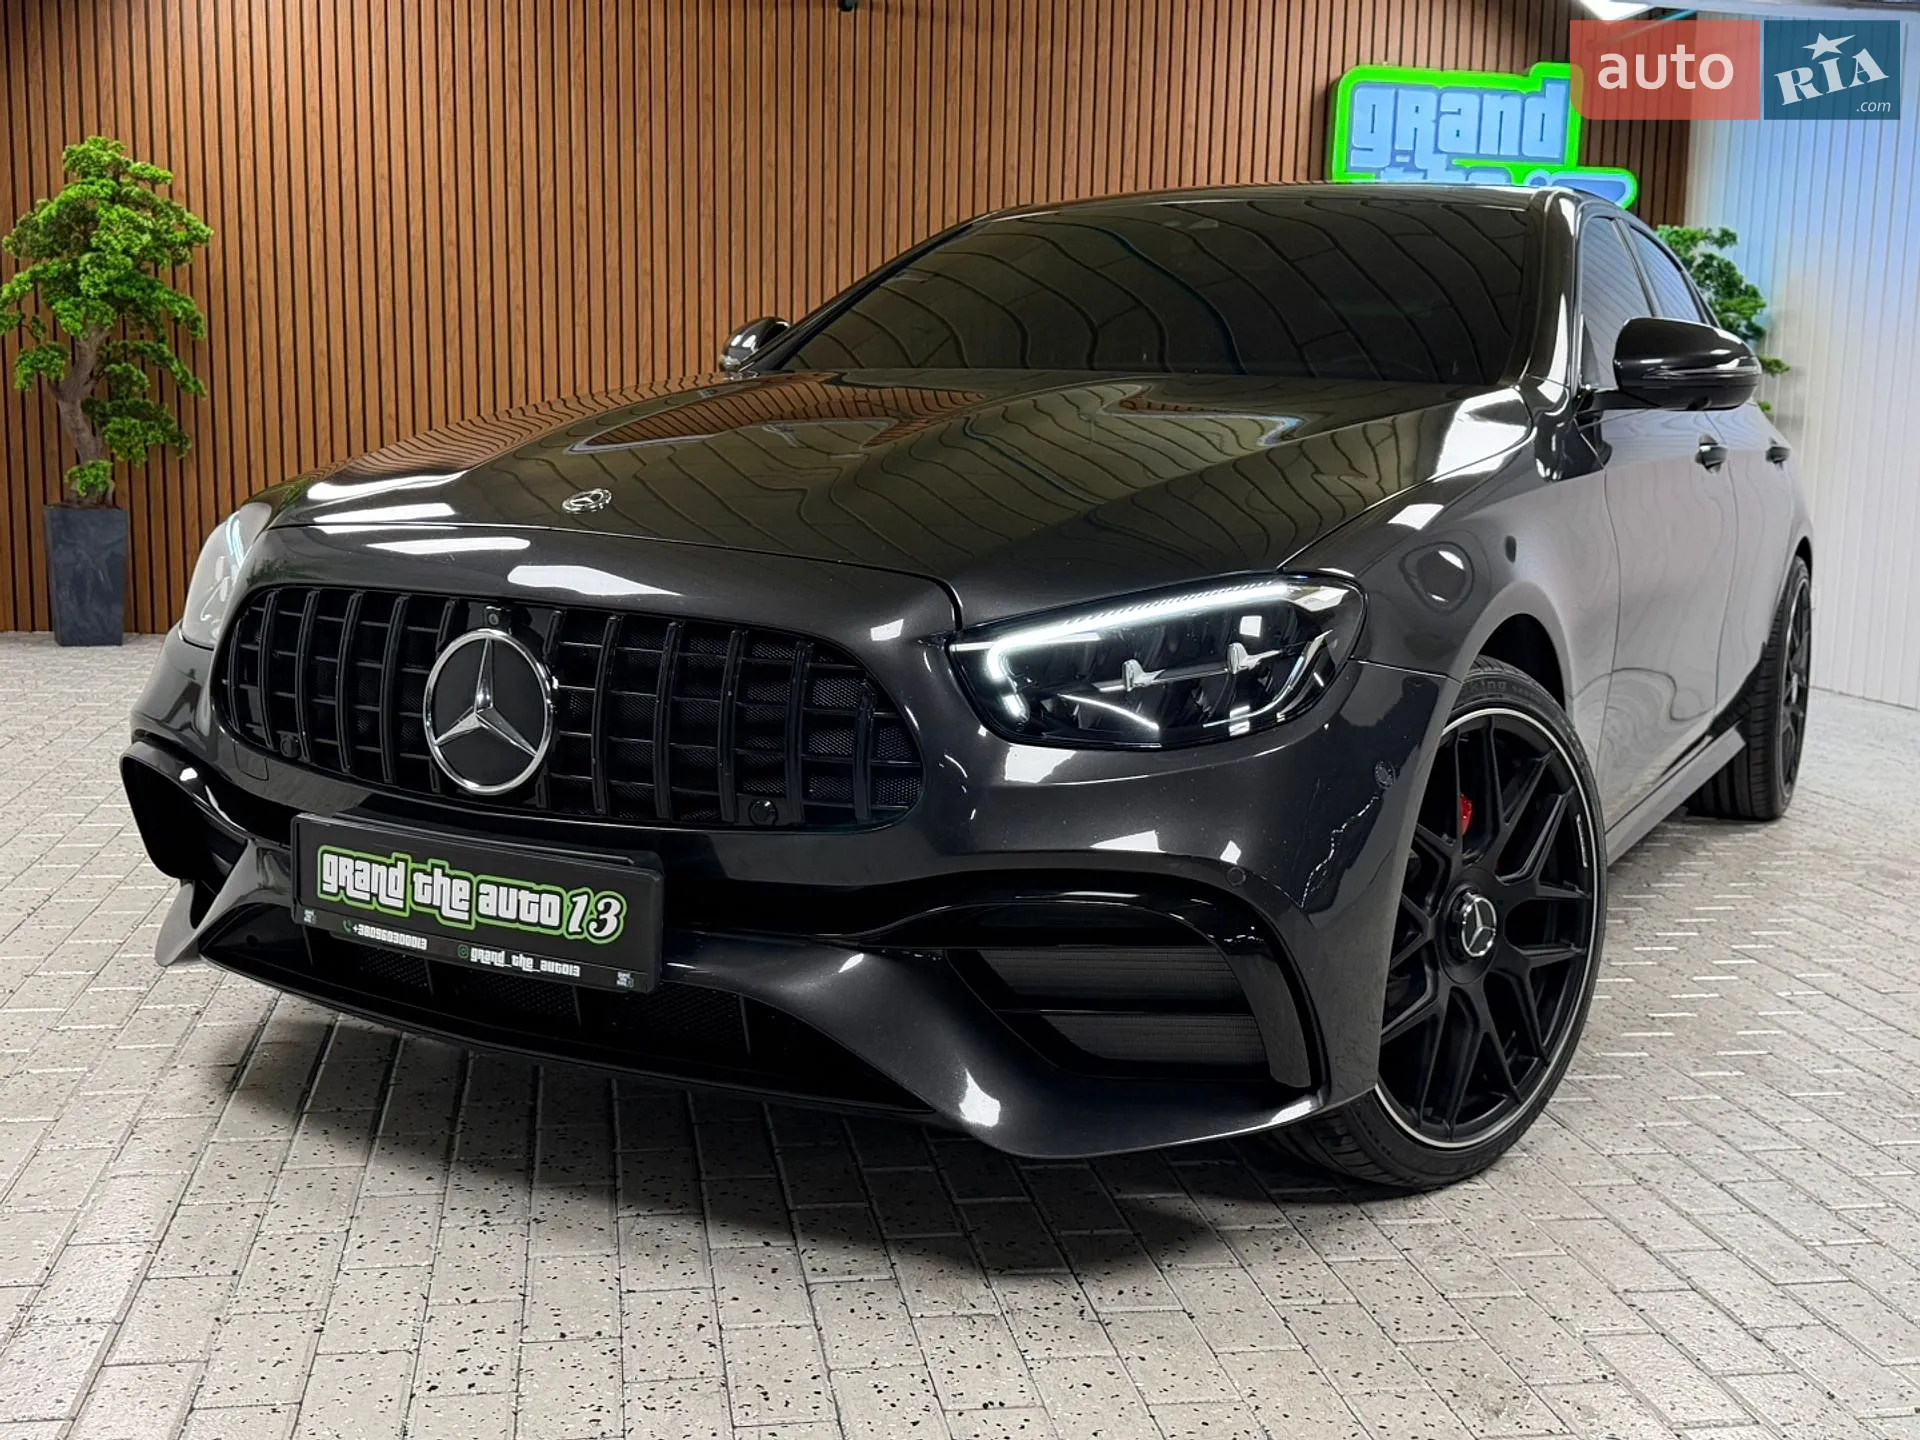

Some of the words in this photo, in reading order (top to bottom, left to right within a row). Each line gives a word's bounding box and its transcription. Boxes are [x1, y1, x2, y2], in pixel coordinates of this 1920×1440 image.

[322, 853, 406, 909] grand
[413, 868, 470, 921] the
[479, 883, 561, 927] auto
